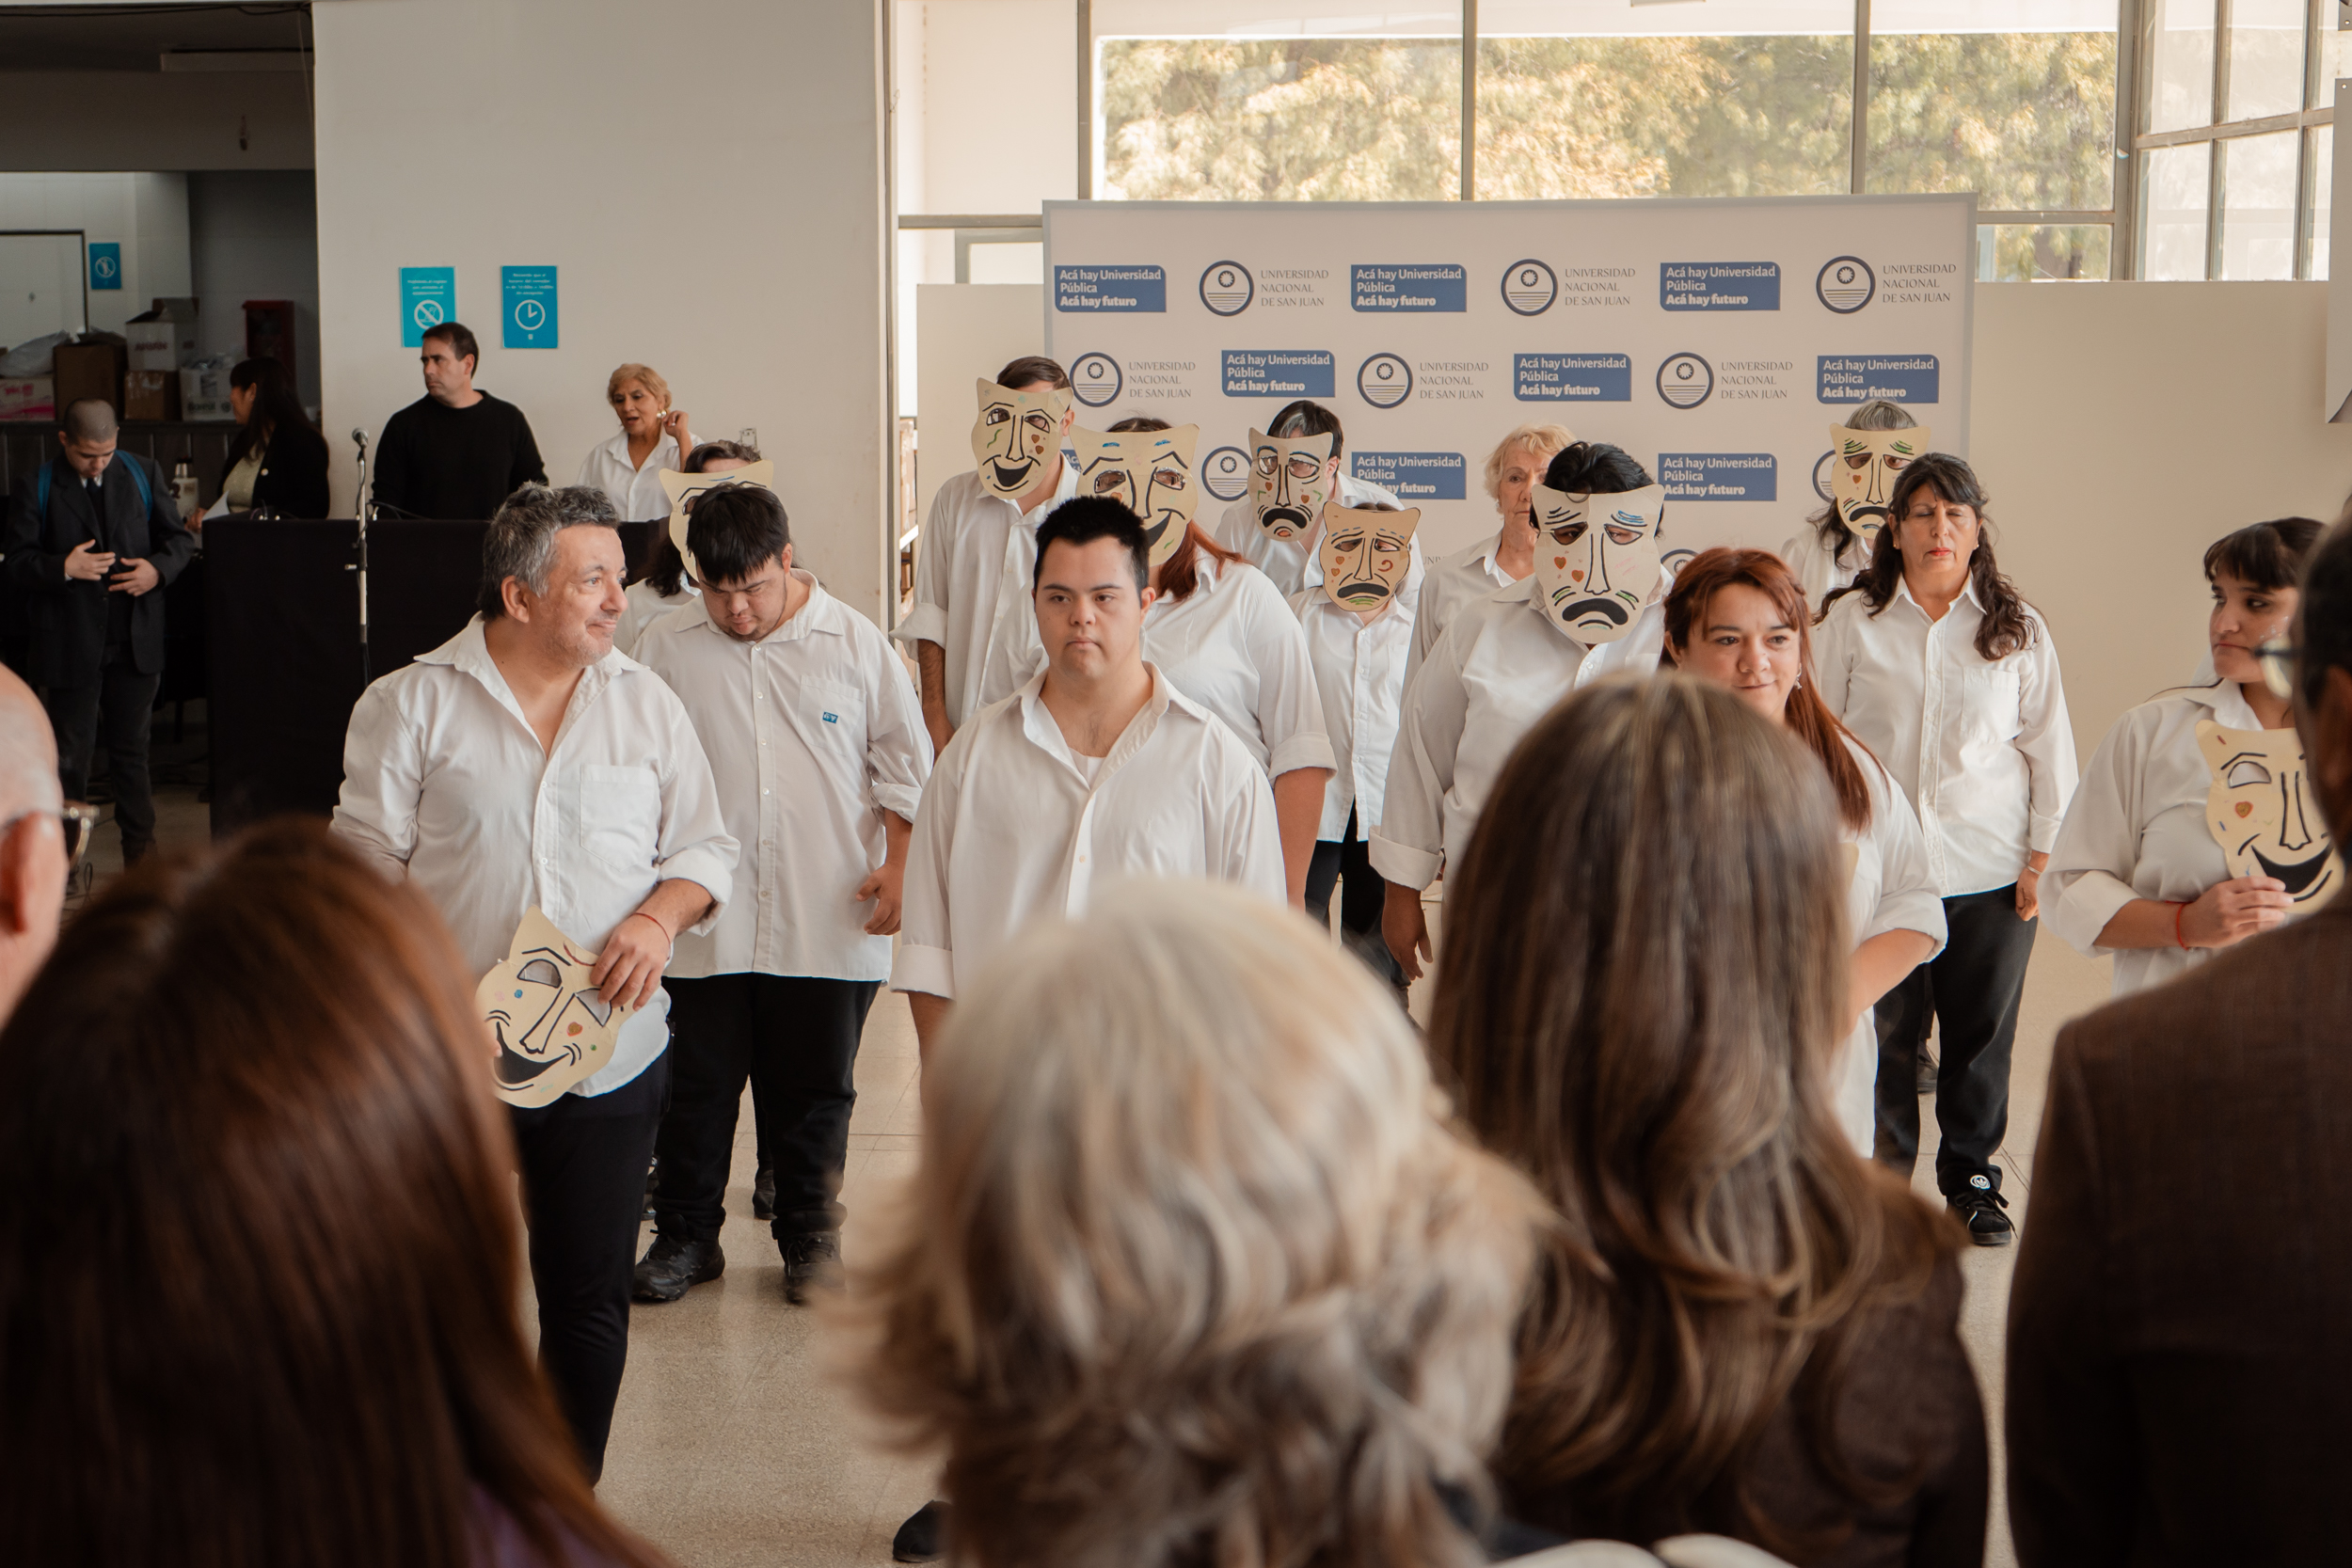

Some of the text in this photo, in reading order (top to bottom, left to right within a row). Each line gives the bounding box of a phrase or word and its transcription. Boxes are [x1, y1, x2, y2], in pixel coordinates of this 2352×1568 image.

[1261, 269, 1329, 279] UNIVERSIDAD
[1565, 267, 1636, 277] UNIVERSIDAD
[1665, 266, 1776, 280] Acá hay Universidad
[1883, 263, 1957, 275] UNIVERSIDAD
[1059, 269, 1162, 282] Acá hay Universidad
[1356, 268, 1462, 282] Acá hay Universidad
[1059, 282, 1098, 293] Pública
[1261, 283, 1314, 293] NACIONAL
[1357, 282, 1396, 293] Pública
[1565, 282, 1620, 292] NACIONAL
[1666, 280, 1707, 292] Pública
[1883, 279, 1940, 289] NACIONAL
[1059, 295, 1137, 309] Acá hay futuro
[1261, 297, 1325, 308] DE SAN JUAN
[1356, 294, 1437, 309] Acá hay futuro
[1565, 296, 1631, 307] DE SAN JUAN
[1665, 293, 1749, 308] Acá hay futuro
[1883, 293, 1950, 303] DE SAN JUAN
[1129, 361, 1197, 372] UNIVERSIDAD
[1226, 354, 1330, 368] Acá hay Universidad
[1519, 357, 1627, 372] Acá hay Universidad
[1721, 361, 1793, 372] UNIVERSIDAD
[1822, 359, 1934, 373] Acá hay Universidad
[1227, 367, 1265, 378] Pública
[1420, 362, 1489, 372] UNIVERSIDAD
[1129, 375, 1182, 385] NACIONAL
[1420, 376, 1474, 386] NACIONAL
[1519, 371, 1559, 382] Pública
[1721, 375, 1777, 385] NACIONAL
[1823, 372, 1864, 384] Pública
[1226, 380, 1306, 394] Acá hay futuro
[1518, 384, 1601, 398] Acá hay futuro
[1129, 388, 1192, 399] DE SAN JUAN
[1420, 389, 1485, 400] DE SAN JUAN
[1721, 389, 1788, 400] DE SAN JUAN
[1821, 387, 1907, 402] Acá hay futuro
[1357, 456, 1462, 469] Acá hay Universidad
[1663, 457, 1772, 471] Acá hay Universidad
[1357, 468, 1396, 481] Pública
[1663, 470, 1704, 482] Pública
[1400, 483, 1437, 494] futuro
[1664, 483, 1746, 498] Acá hay futuro
